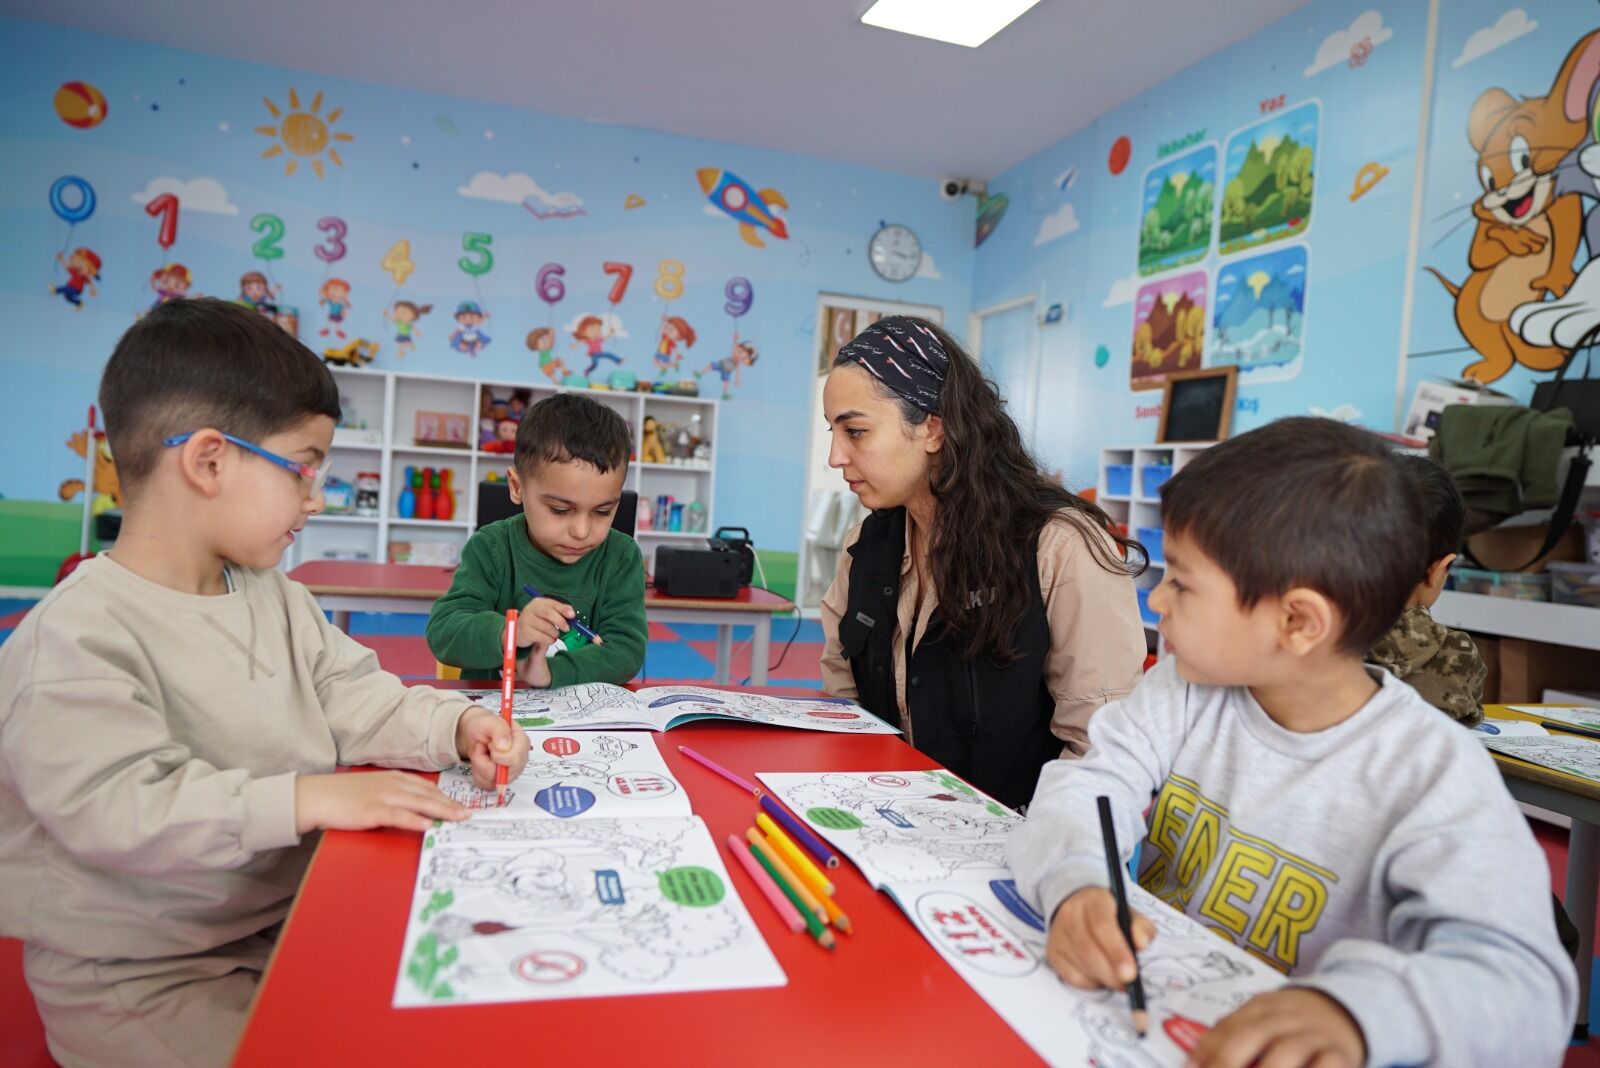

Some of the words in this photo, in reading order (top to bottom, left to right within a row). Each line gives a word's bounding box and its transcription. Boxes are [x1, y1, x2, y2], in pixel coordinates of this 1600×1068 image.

[146, 193, 178, 249] 1
[250, 213, 285, 258] 2
[314, 216, 347, 262] 3
[380, 239, 415, 285] 4
[458, 232, 494, 276] 5
[535, 262, 566, 303] 6
[603, 261, 633, 304] 7
[655, 258, 686, 300] 8
[724, 276, 754, 317] 9
[931, 908, 994, 955] 112
